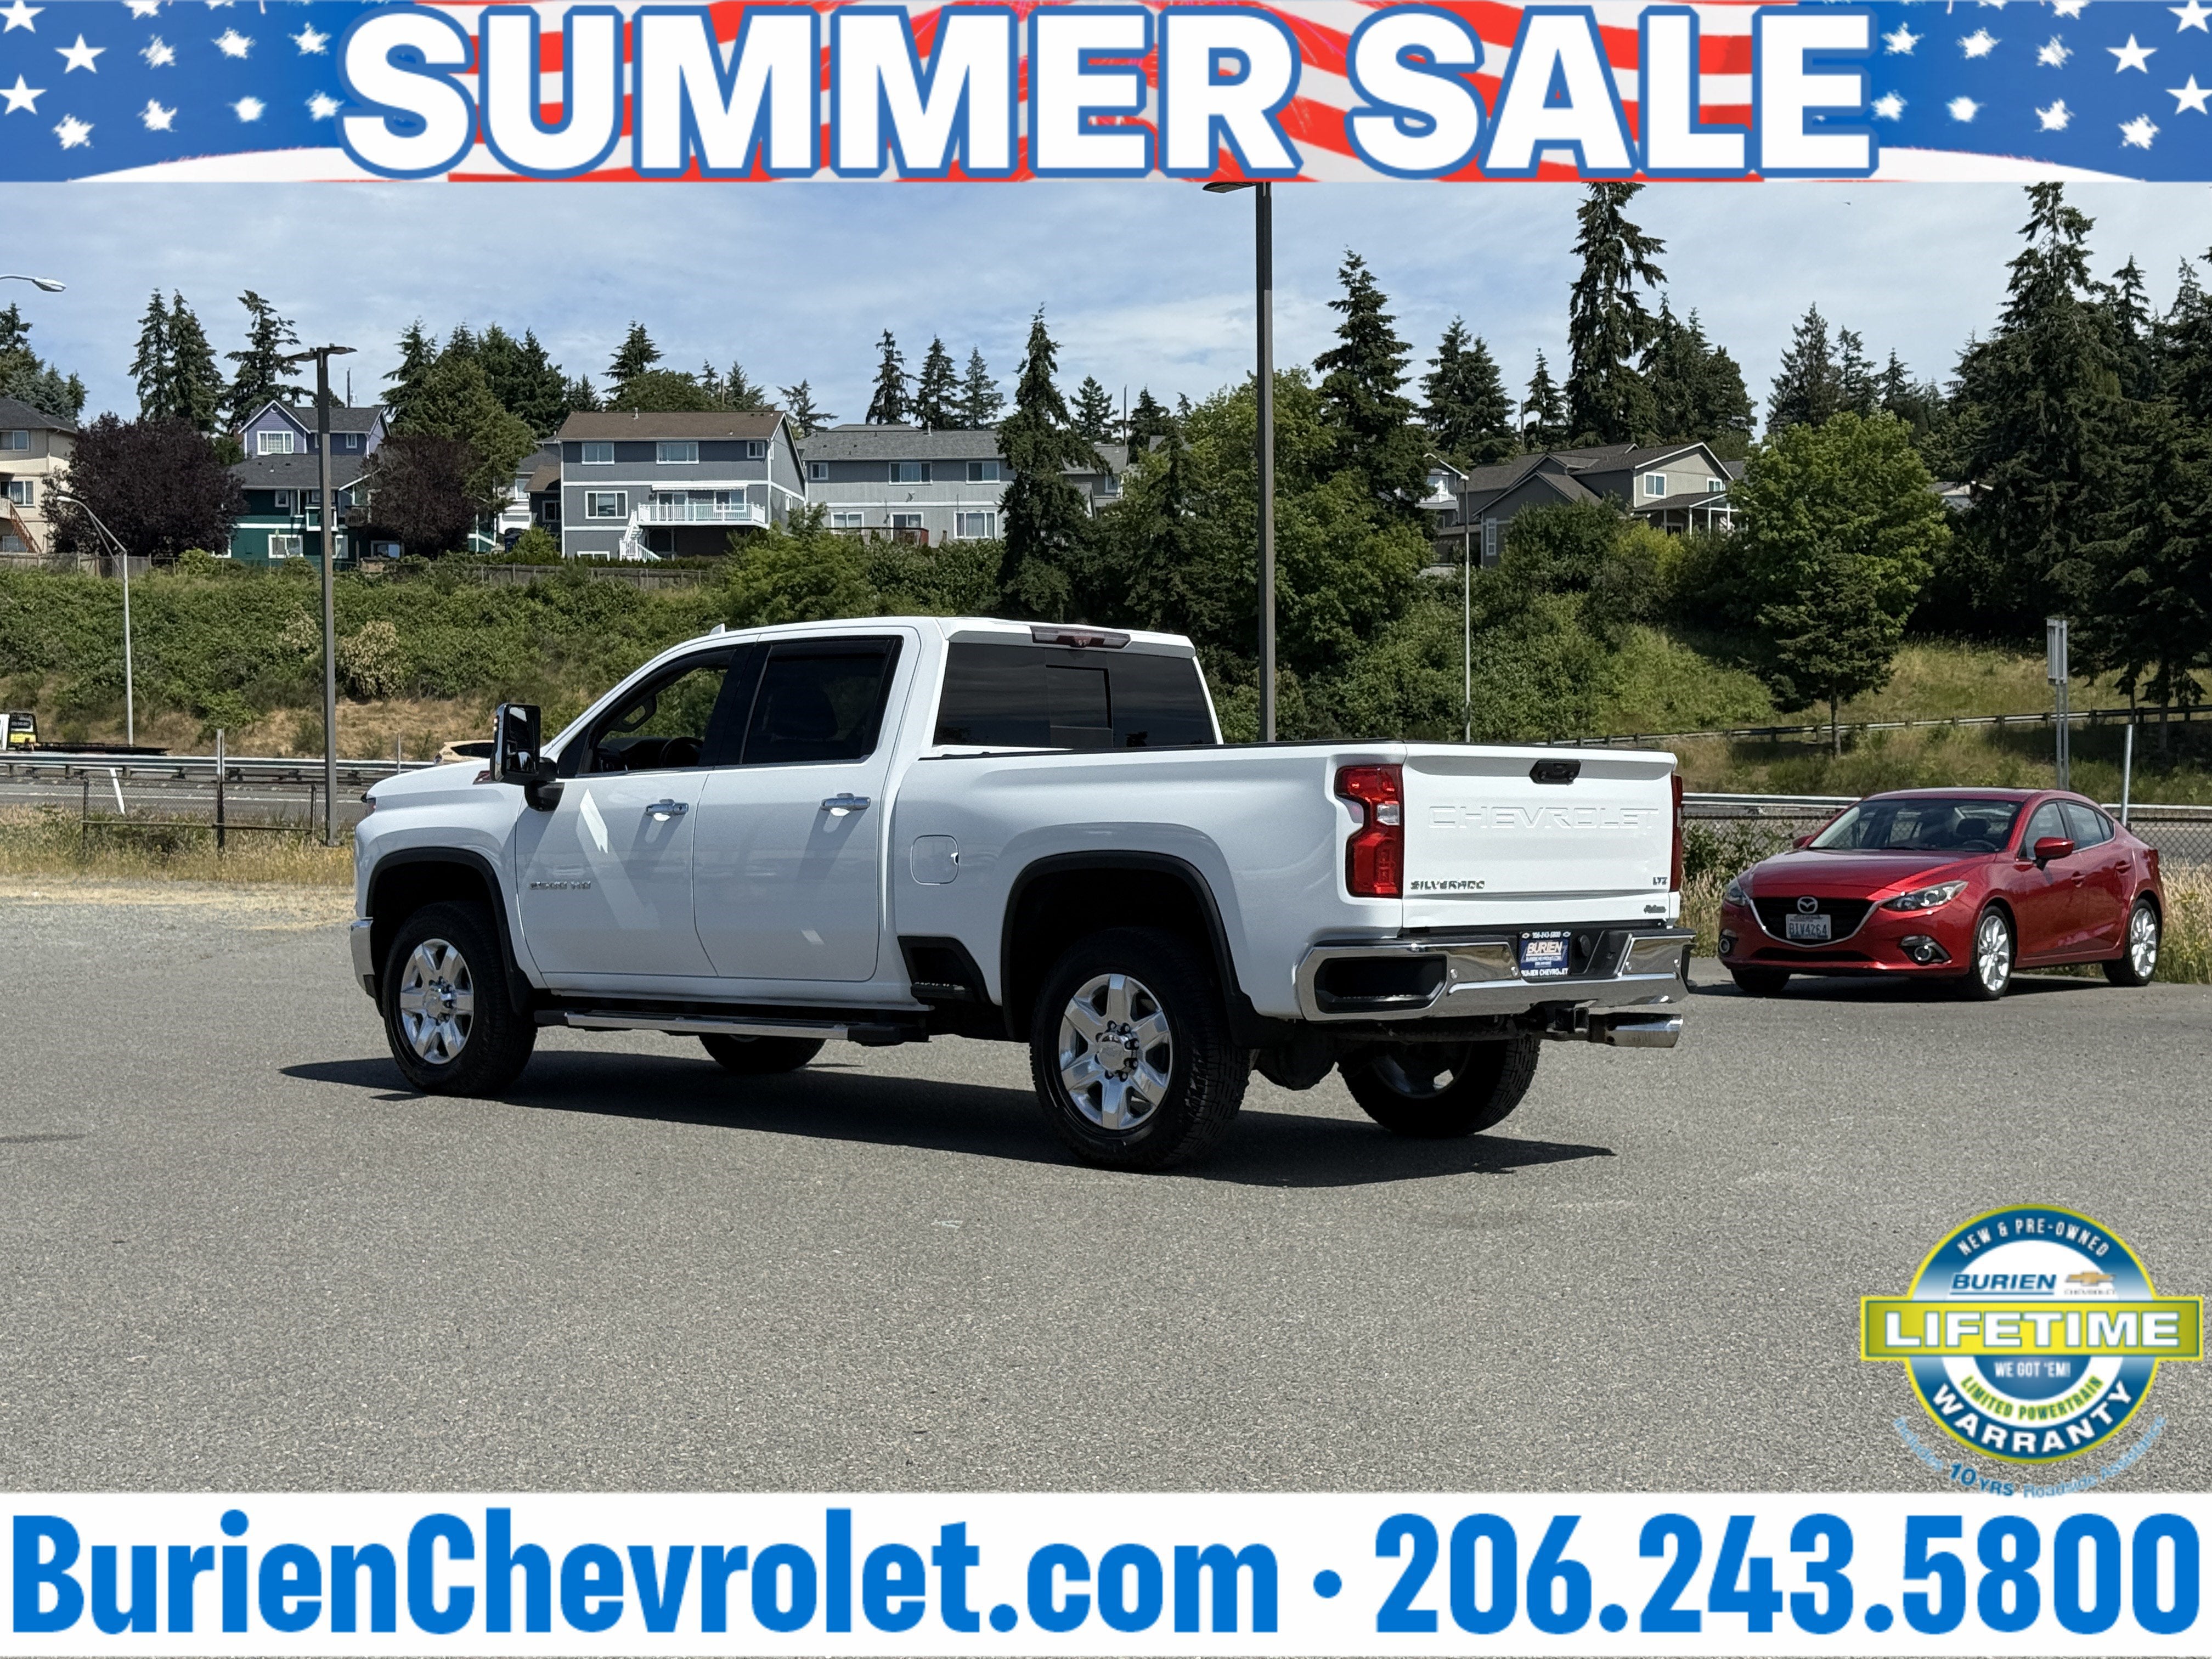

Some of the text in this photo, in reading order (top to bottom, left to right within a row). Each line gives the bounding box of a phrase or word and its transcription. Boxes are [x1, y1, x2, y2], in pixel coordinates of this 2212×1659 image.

[1429, 806, 1658, 829] CHEVROLET
[1410, 881, 1485, 890] SILVERADO
[1653, 877, 1668, 885] LTZ
[1527, 941, 1563, 954] BURIEN
[1539, 968, 1568, 976] CHEVROLET
